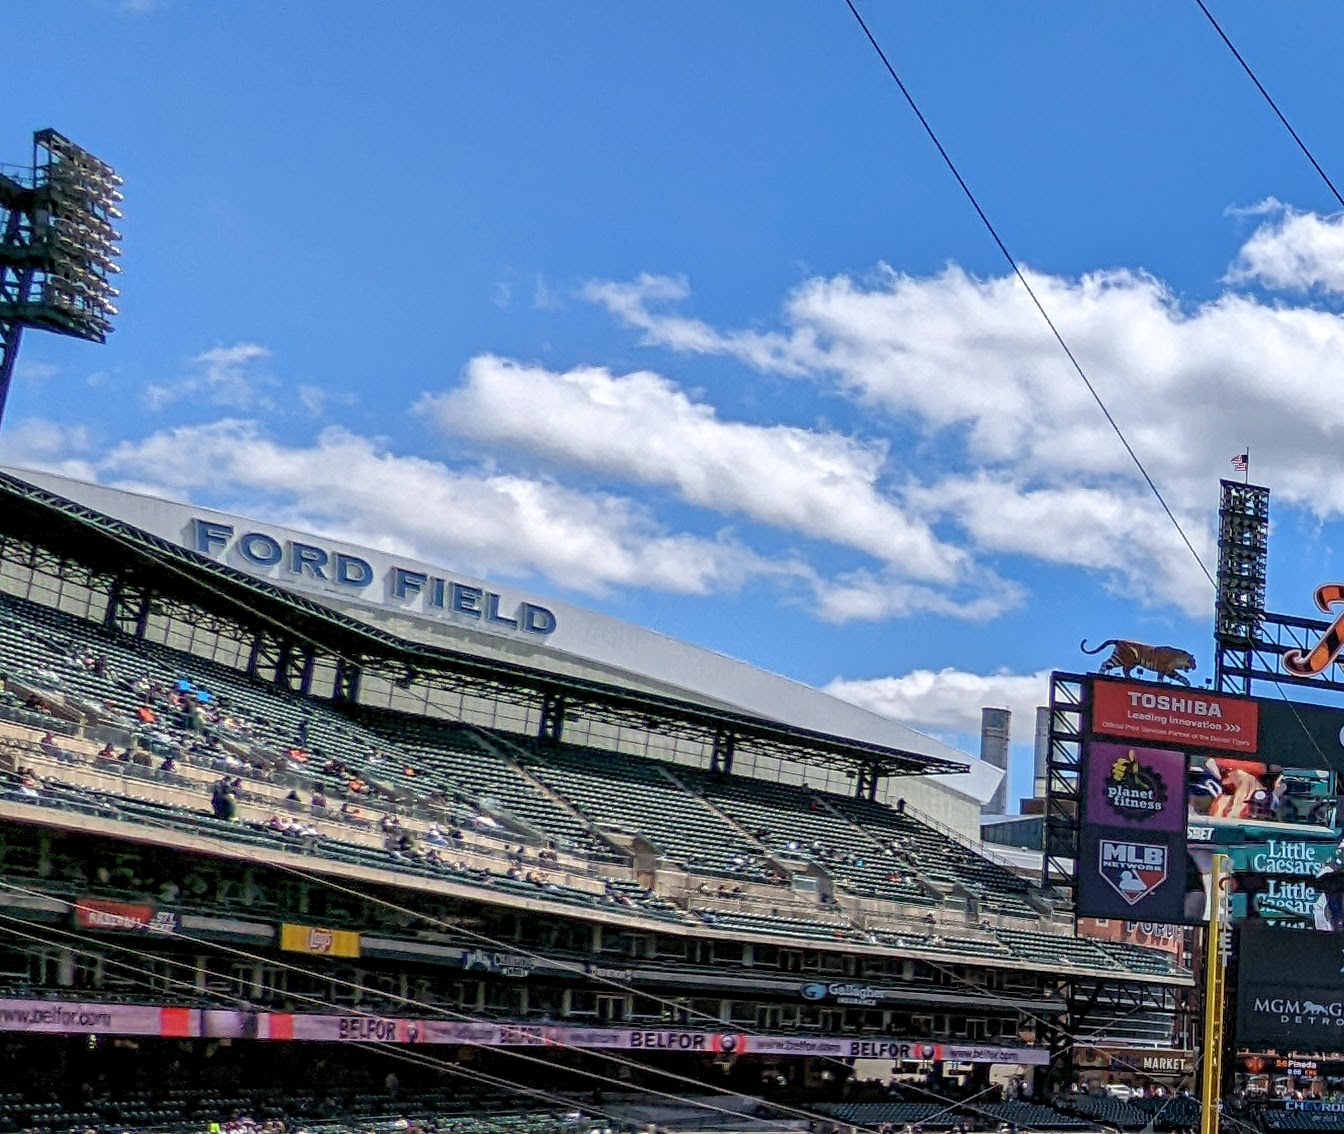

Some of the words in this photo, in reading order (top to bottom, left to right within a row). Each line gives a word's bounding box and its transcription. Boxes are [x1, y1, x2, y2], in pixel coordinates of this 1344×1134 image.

[190, 517, 374, 588] FORD
[391, 565, 558, 636] FIELD
[1127, 691, 1223, 718] TOSHIBA
[1127, 710, 1167, 725] Leading
[1169, 715, 1222, 732] Innovation
[1107, 784, 1154, 800] planet
[1113, 795, 1162, 811] fitness
[1102, 843, 1164, 865] MLB
[1265, 839, 1316, 861] Little
[1102, 860, 1163, 872] NETWORK
[1265, 879, 1316, 901] Little
[828, 983, 886, 999] Gallagher
[1253, 997, 1303, 1014] MGM
[338, 1017, 397, 1040] BELFOR
[630, 1031, 706, 1050] BELFOR
[849, 1041, 909, 1058] BELFOR
[1143, 1057, 1186, 1071] MARKET
